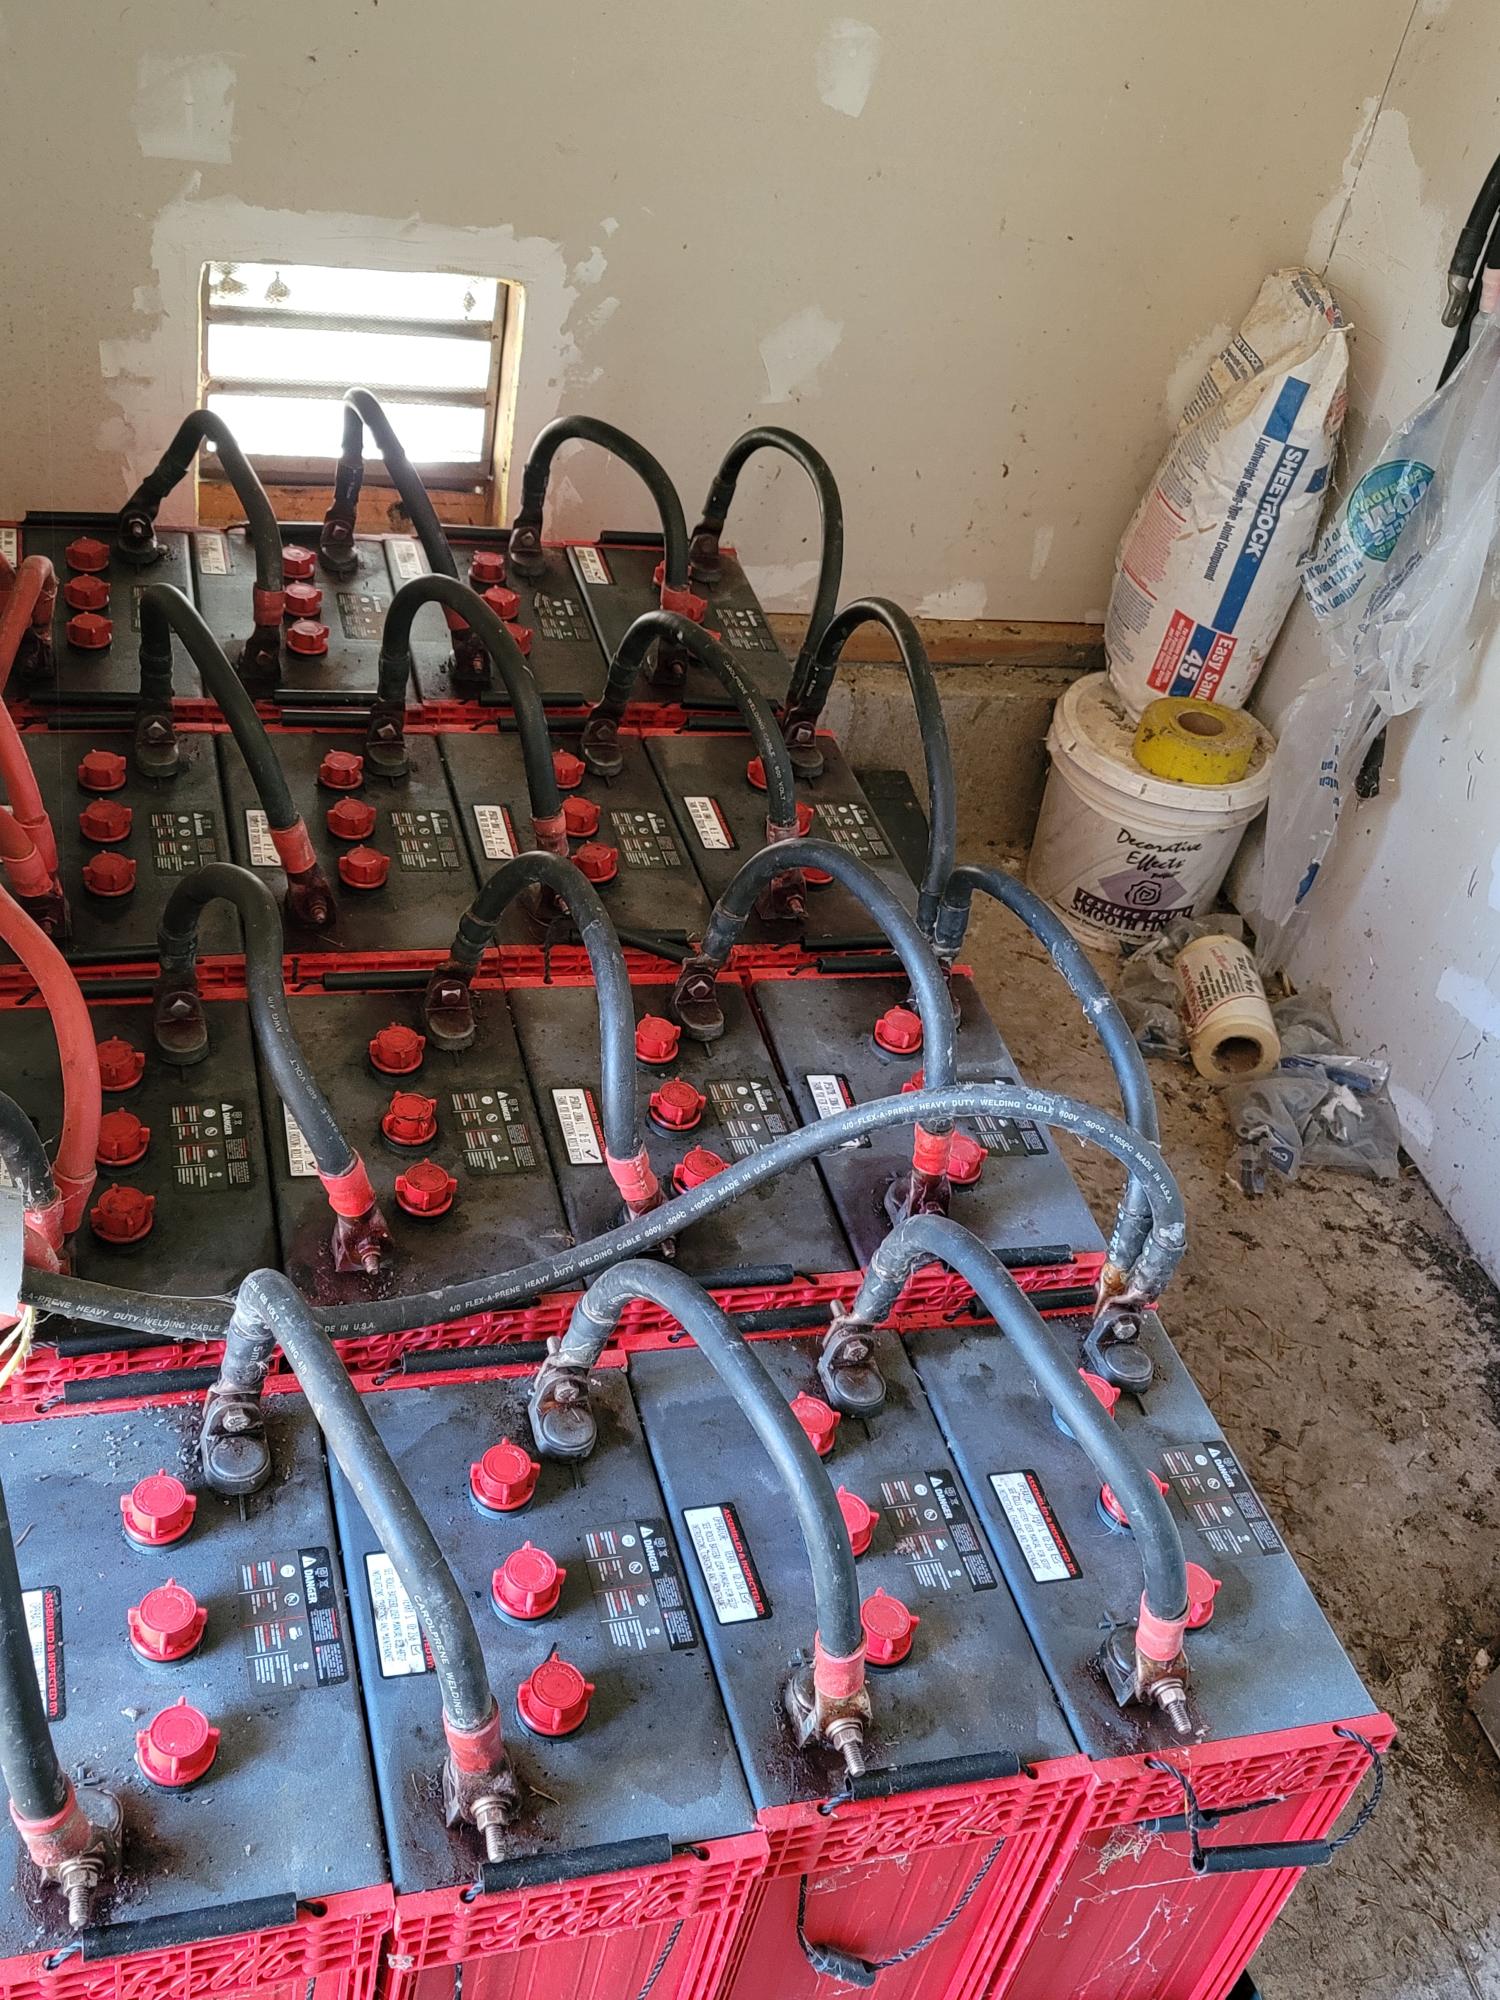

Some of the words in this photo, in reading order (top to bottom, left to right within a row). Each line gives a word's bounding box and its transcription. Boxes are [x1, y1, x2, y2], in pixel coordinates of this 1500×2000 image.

[1241, 436, 1271, 483] Lightweight
[1244, 449, 1303, 559] SHEETROCK
[1218, 521, 1236, 543] Joint
[1203, 541, 1229, 581] Compound
[1179, 649, 1203, 681] 45
[1208, 638, 1234, 670] Easy
[747, 697, 765, 730] WELDING
[763, 732, 776, 758] CABLE
[777, 781, 787, 801] VOLT
[1116, 827, 1203, 853] Decorative
[1126, 851, 1186, 872] Effects
[1070, 901, 1138, 932] SMOOTH
[1141, 919, 1168, 932] FIN
[1078, 891, 1141, 919] Texture
[271, 1012, 283, 1033] AWG
[289, 1058, 306, 1082] VOLT
[499, 1099, 512, 1121] DANGER
[841, 1120, 854, 1131] 4/0
[918, 1100, 947, 1110] HEAVY
[952, 1099, 976, 1108] DUTY
[980, 1098, 1021, 1109] WELDING
[1025, 1102, 1056, 1114] CABLE
[1059, 1109, 1080, 1123] 600V
[1134, 1151, 1155, 1174] MADE
[1152, 1171, 1163, 1184] IN
[448, 1302, 461, 1313] 4/0
[464, 1284, 521, 1309] FLEX-A-PRENE
[524, 1274, 551, 1290] HEAVY
[553, 1264, 575, 1280] DUTY
[578, 1248, 614, 1269] WELDING
[616, 1234, 642, 1252] CABLE
[643, 1223, 663, 1238] 600V
[717, 1179, 741, 1197] MADE
[741, 1170, 752, 1183] IN
[753, 1159, 777, 1175] U.S.A.
[76, 1304, 110, 1319] HEAVY
[113, 1311, 140, 1324] DUTY
[142, 1316, 186, 1331] WELDING
[190, 1322, 220, 1333] CABLE
[266, 1303, 280, 1322] VOLT
[286, 1340, 300, 1360] AWG
[339, 1323, 350, 1332] IN
[1214, 1458, 1235, 1488] DANGER
[935, 1489, 953, 1520] DANGER
[1025, 1474, 1051, 1516] ASSEMBLED
[1047, 1523, 1072, 1562] INSPECTED
[644, 1540, 660, 1572] DANGER
[722, 1507, 744, 1552] ASSEMBLED
[739, 1559, 761, 1601] INSPECTED
[303, 1569, 318, 1604] DANGER
[45, 1592, 56, 1643] ASSEMBLED
[413, 1594, 450, 1665] CAROLPRENE
[445, 1671, 463, 1716] WELDING
[48, 1652, 58, 1703] INSPECTED
